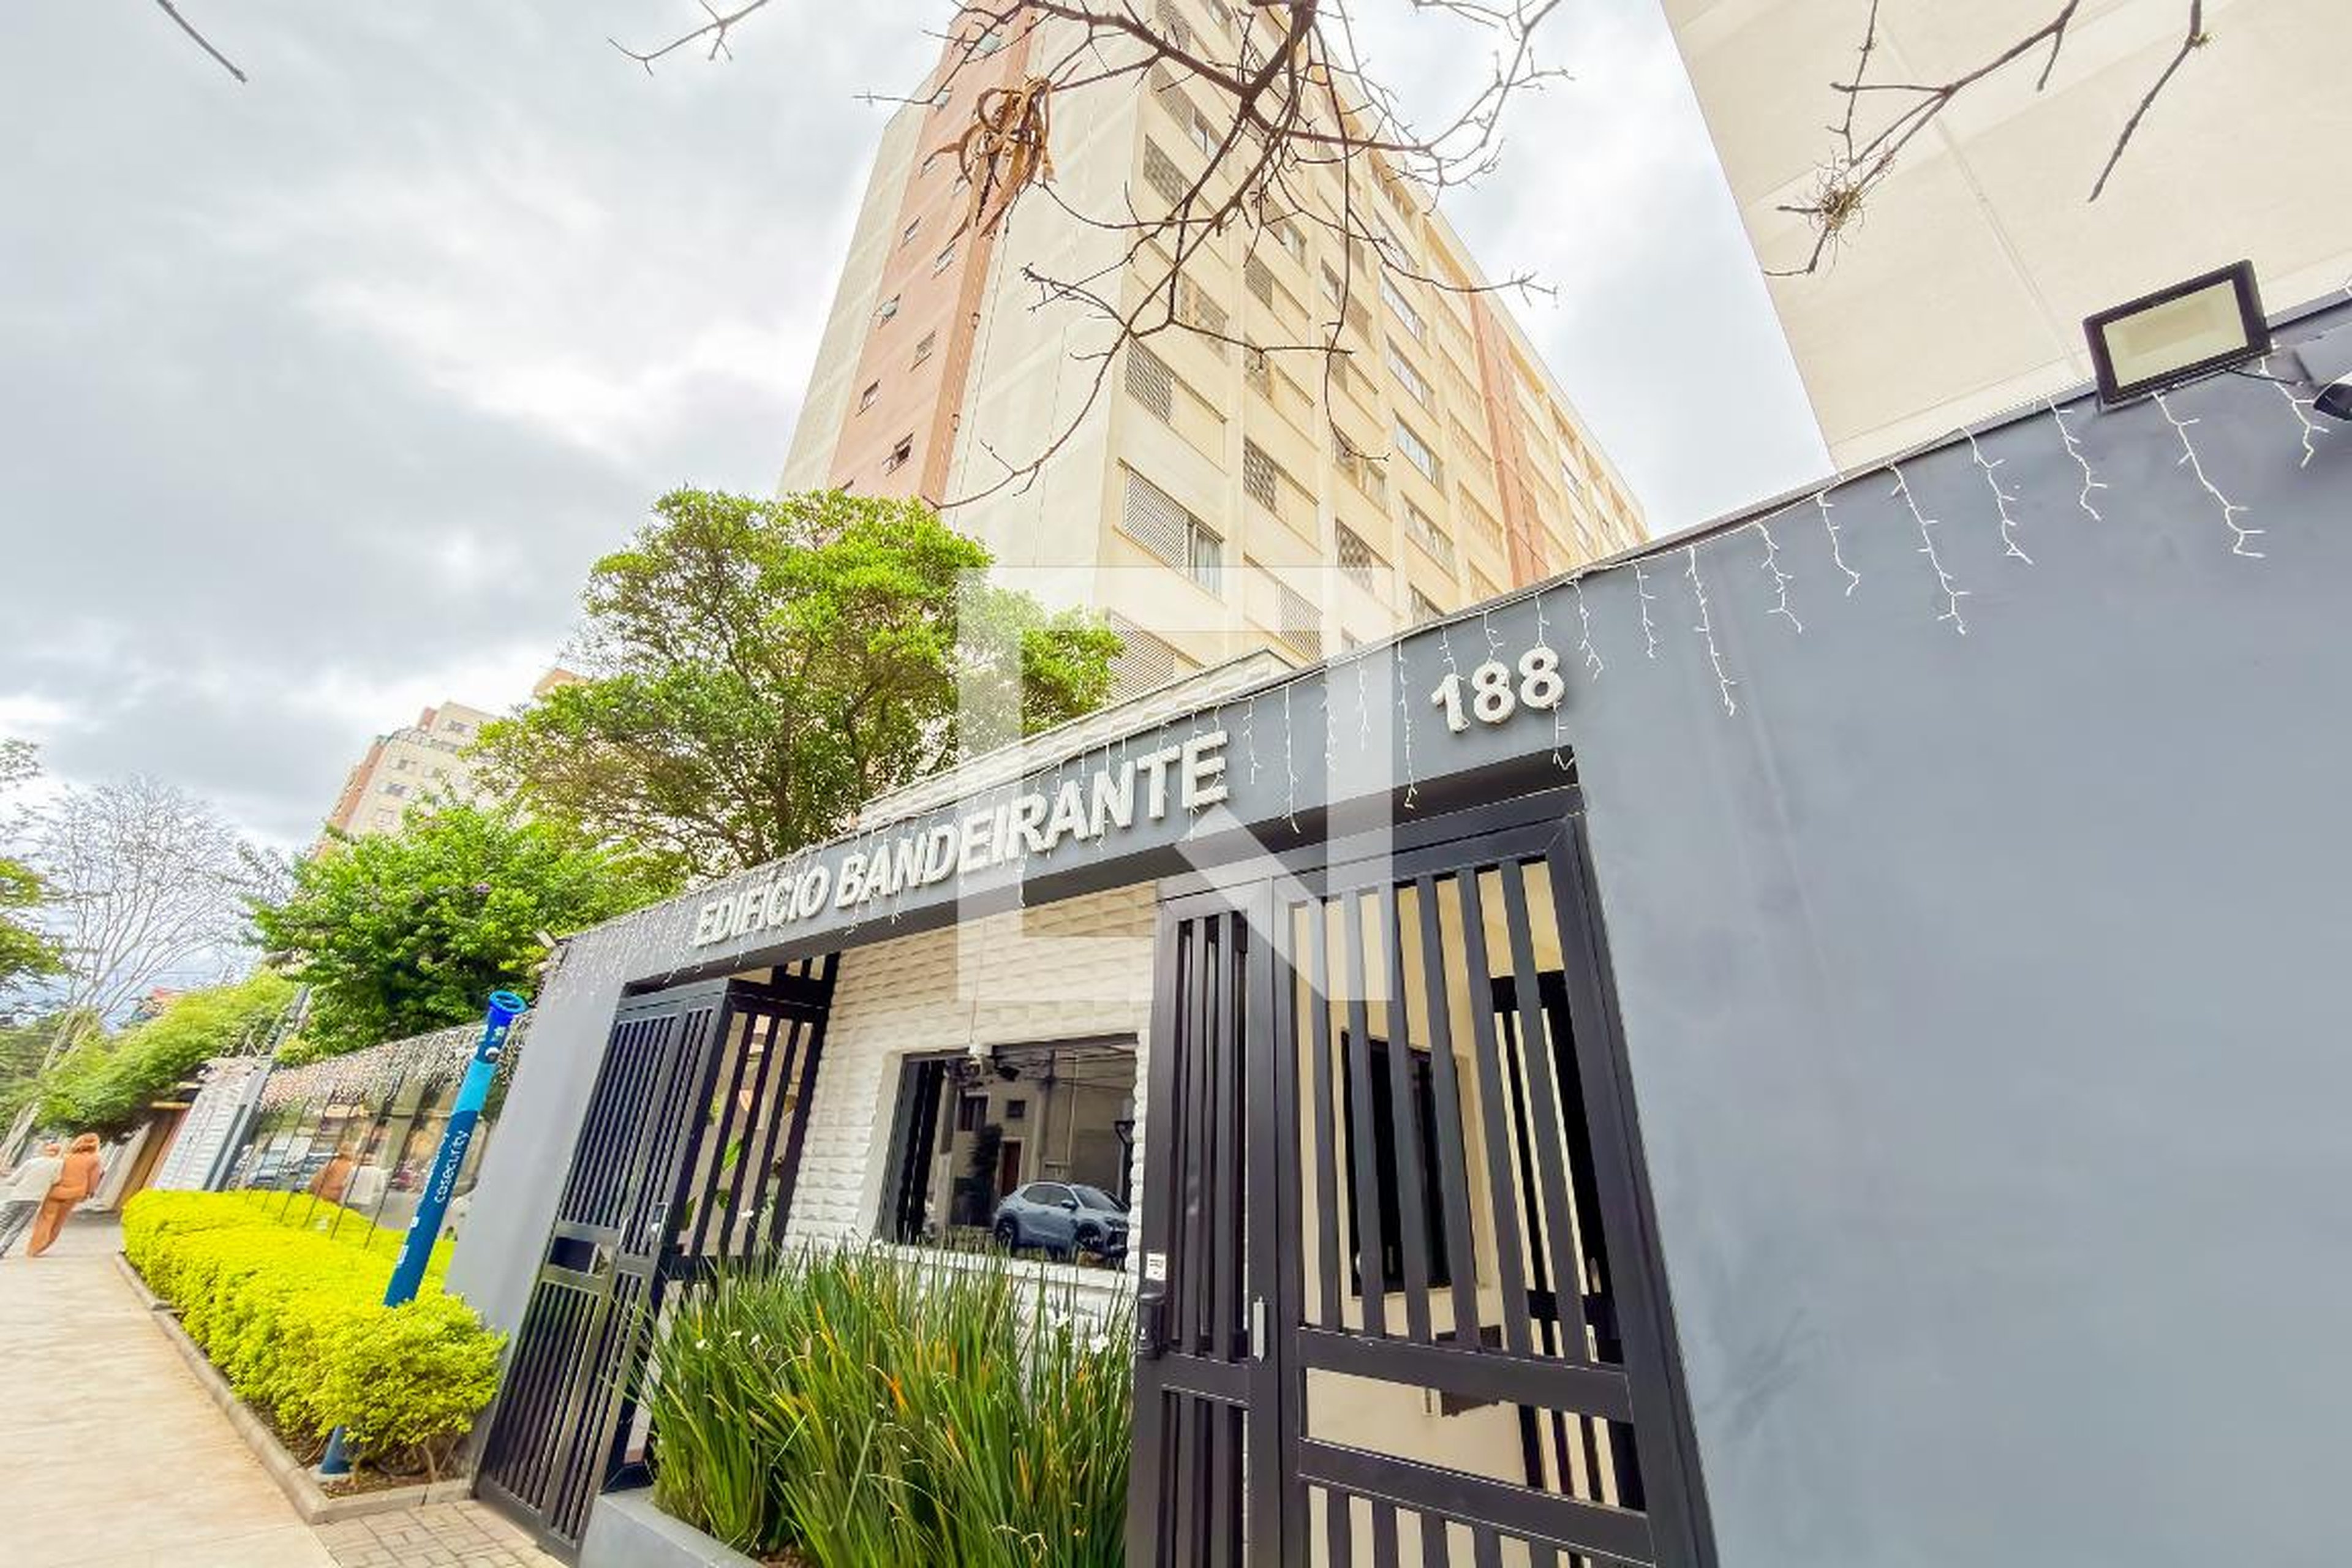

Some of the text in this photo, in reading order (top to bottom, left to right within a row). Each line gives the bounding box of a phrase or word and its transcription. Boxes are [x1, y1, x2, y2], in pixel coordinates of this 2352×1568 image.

[1430, 646, 1564, 733] 188
[835, 731, 1229, 908] BANDEIRANTE
[434, 1131, 470, 1203] cosecurity
